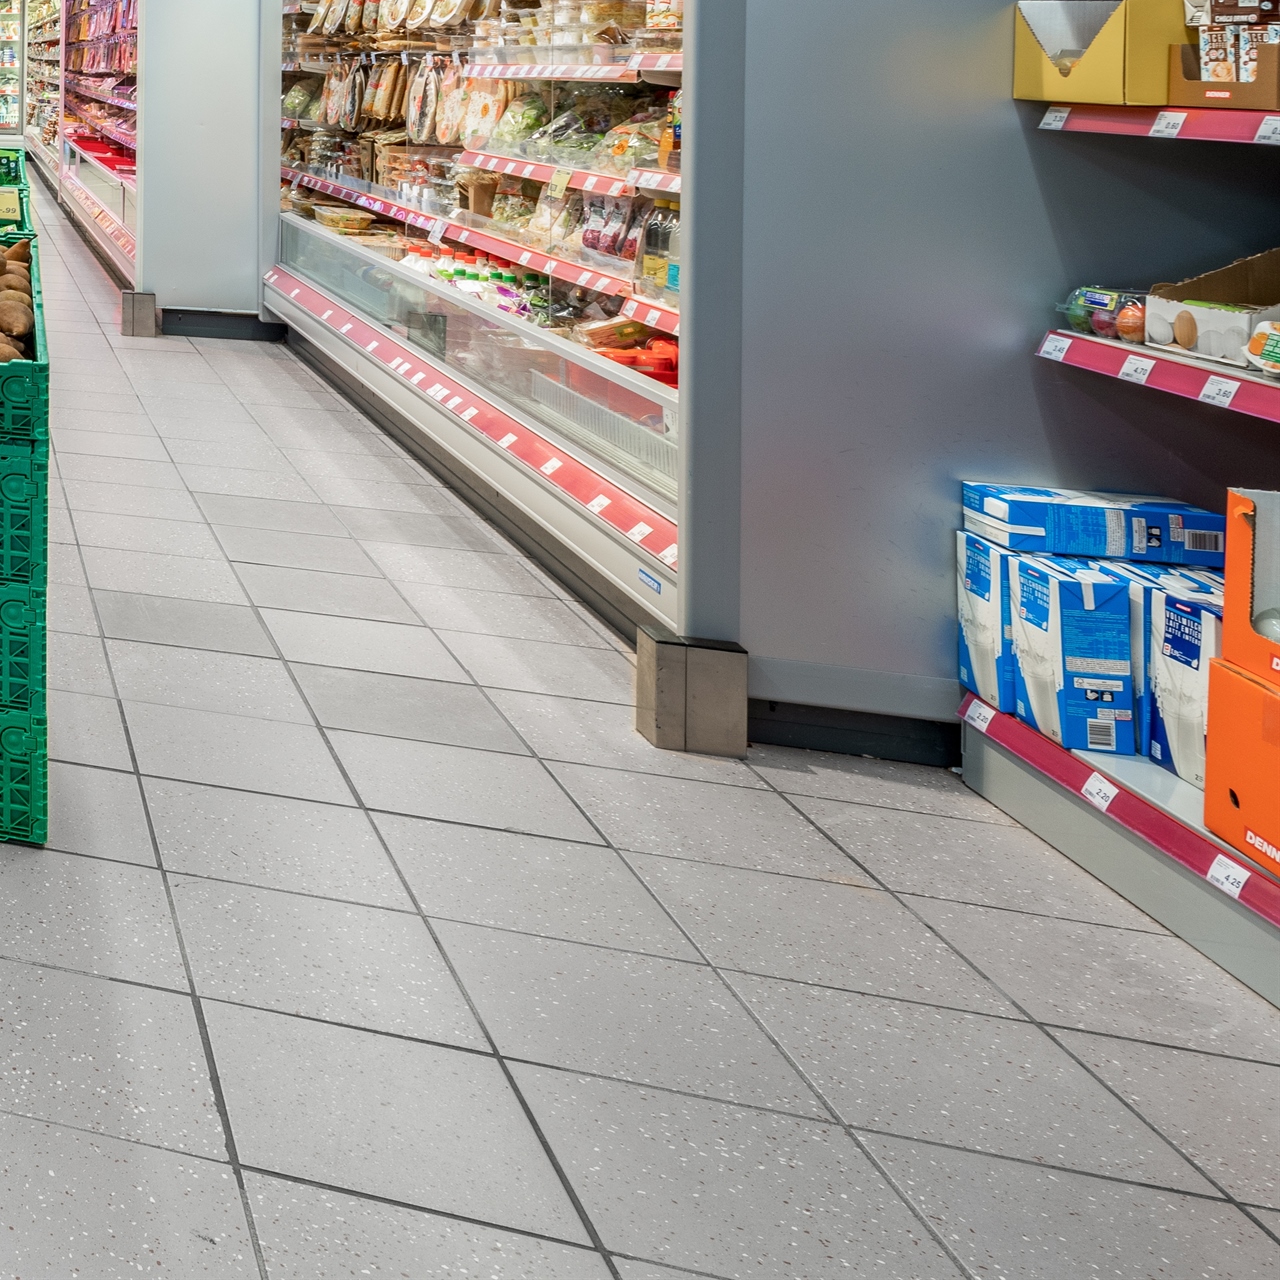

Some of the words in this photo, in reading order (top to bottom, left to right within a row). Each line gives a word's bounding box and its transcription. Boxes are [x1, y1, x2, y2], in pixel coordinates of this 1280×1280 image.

[1209, 33, 1225, 42] ICED
[1165, 122, 1179, 130] 0.60
[1134, 367, 1147, 376] 4.70
[1216, 388, 1231, 398] 3.60
[1020, 585, 1032, 594] LAIT
[1165, 610, 1201, 630] VOLLMILCH
[1165, 618, 1178, 628] LAIT
[1181, 624, 1201, 640] ENTIER
[1165, 626, 1179, 637] LATTE
[977, 712, 989, 723] 2.20
[1096, 788, 1110, 802] 2.20
[1246, 830, 1280, 863] DENN
[1224, 874, 1242, 889] 4.25
